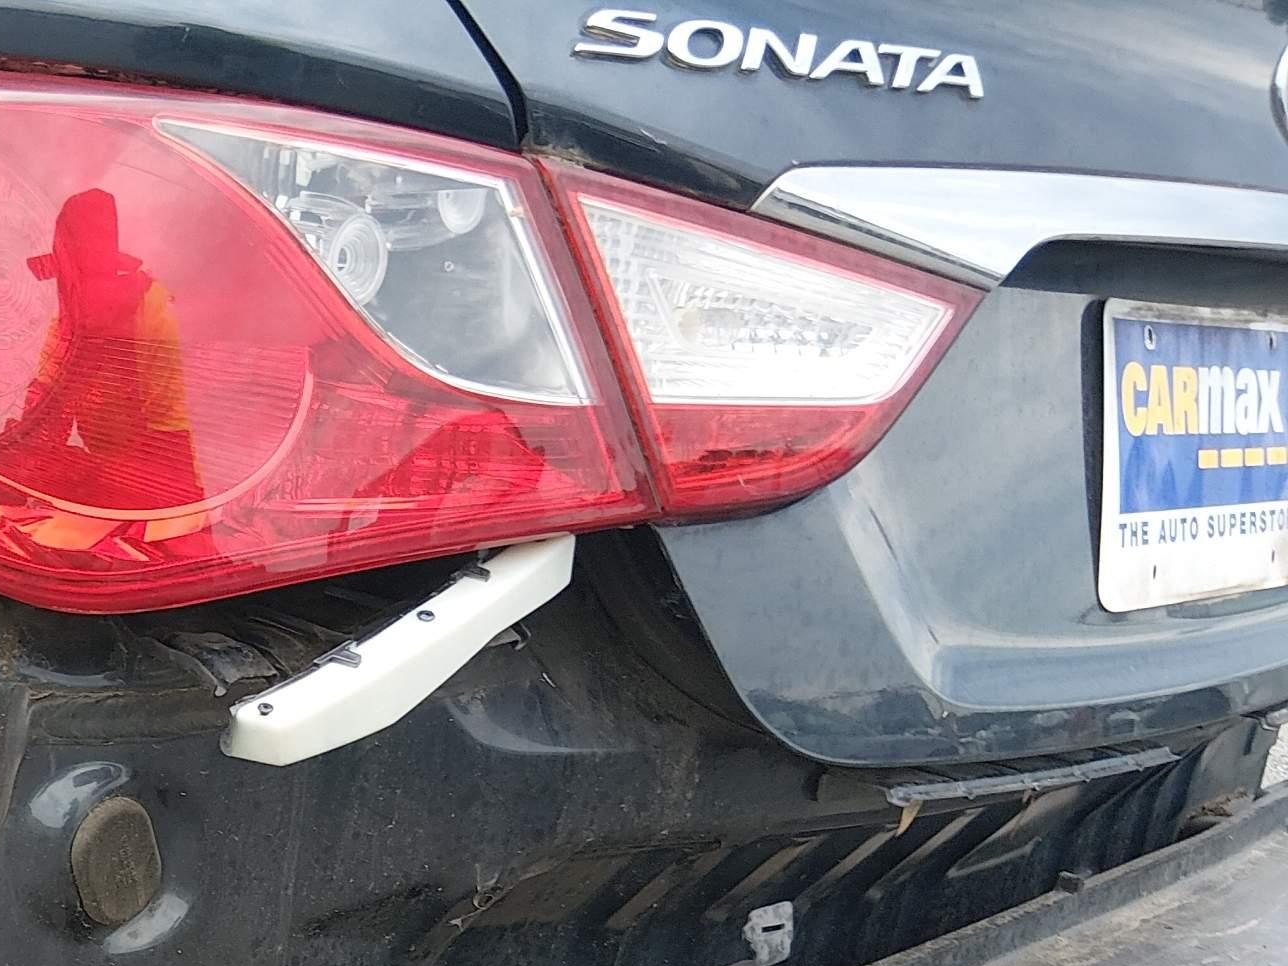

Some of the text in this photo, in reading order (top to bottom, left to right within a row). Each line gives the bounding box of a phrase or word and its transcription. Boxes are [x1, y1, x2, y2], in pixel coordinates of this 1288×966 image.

[571, 8, 984, 98] SONATA
[1119, 507, 1288, 548] THE AUTO SUPERSTO
